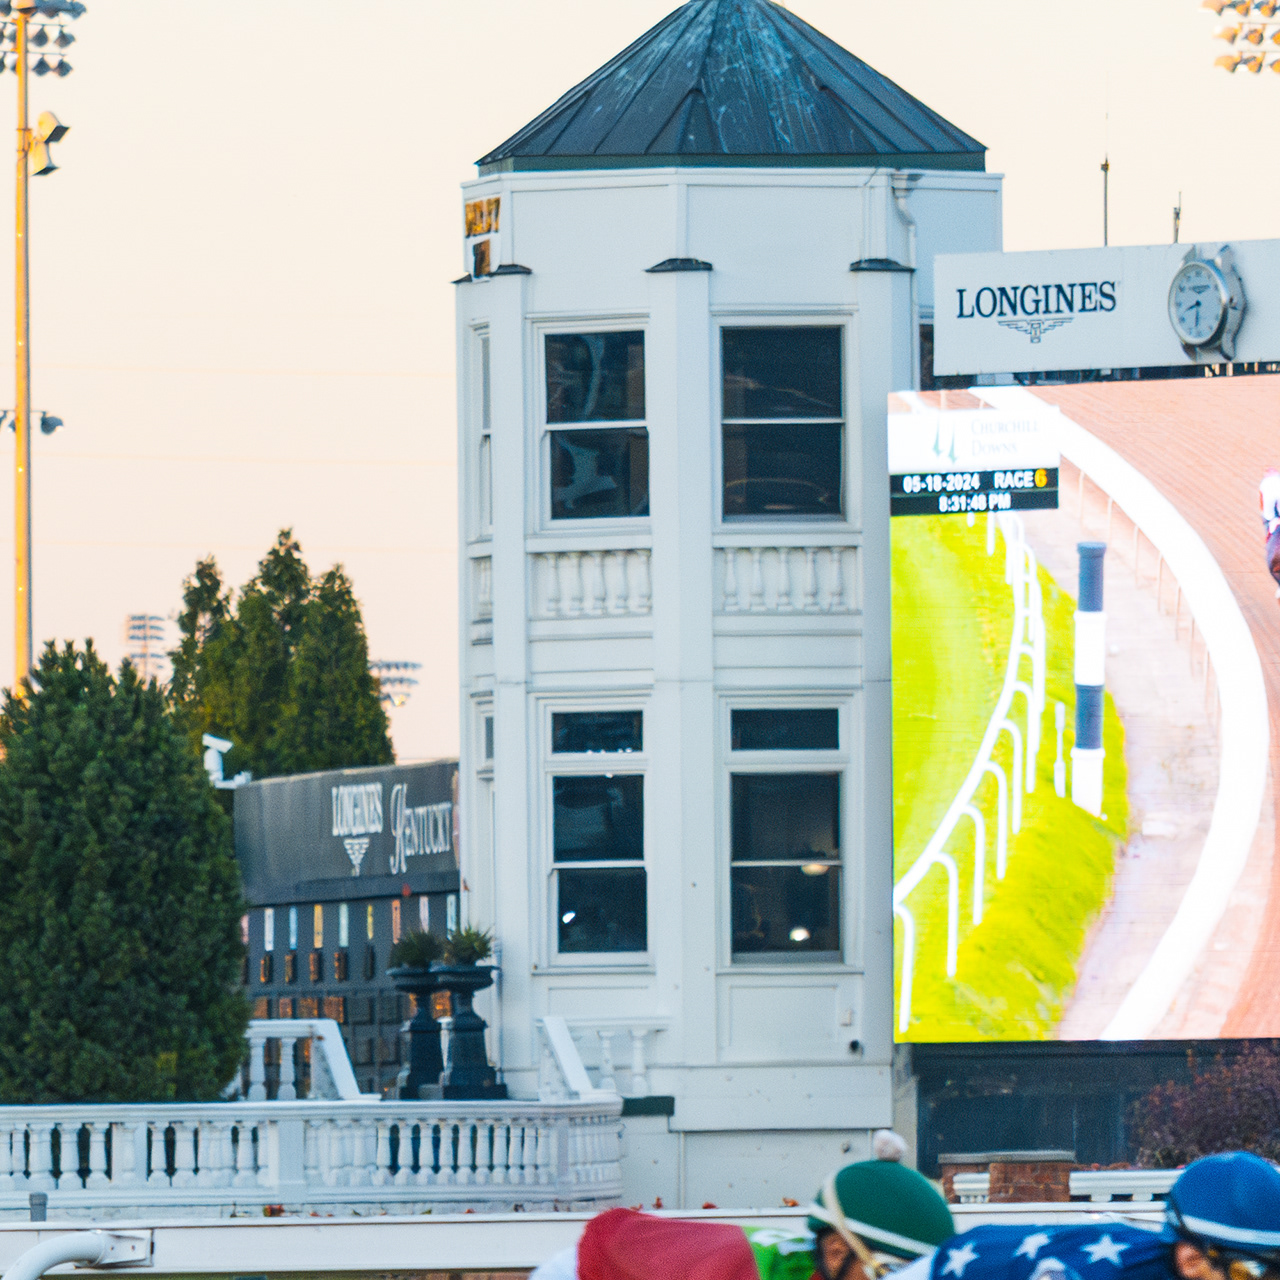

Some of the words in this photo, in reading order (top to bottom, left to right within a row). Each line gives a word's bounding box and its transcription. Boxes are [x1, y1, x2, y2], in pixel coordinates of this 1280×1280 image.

[956, 280, 1117, 319] LONGINES
[971, 418, 1040, 435] CHURCHILL
[972, 440, 1018, 457] DOWNS
[993, 469, 1034, 490] RACE
[1034, 468, 1048, 488] 6
[987, 491, 1012, 510] PM
